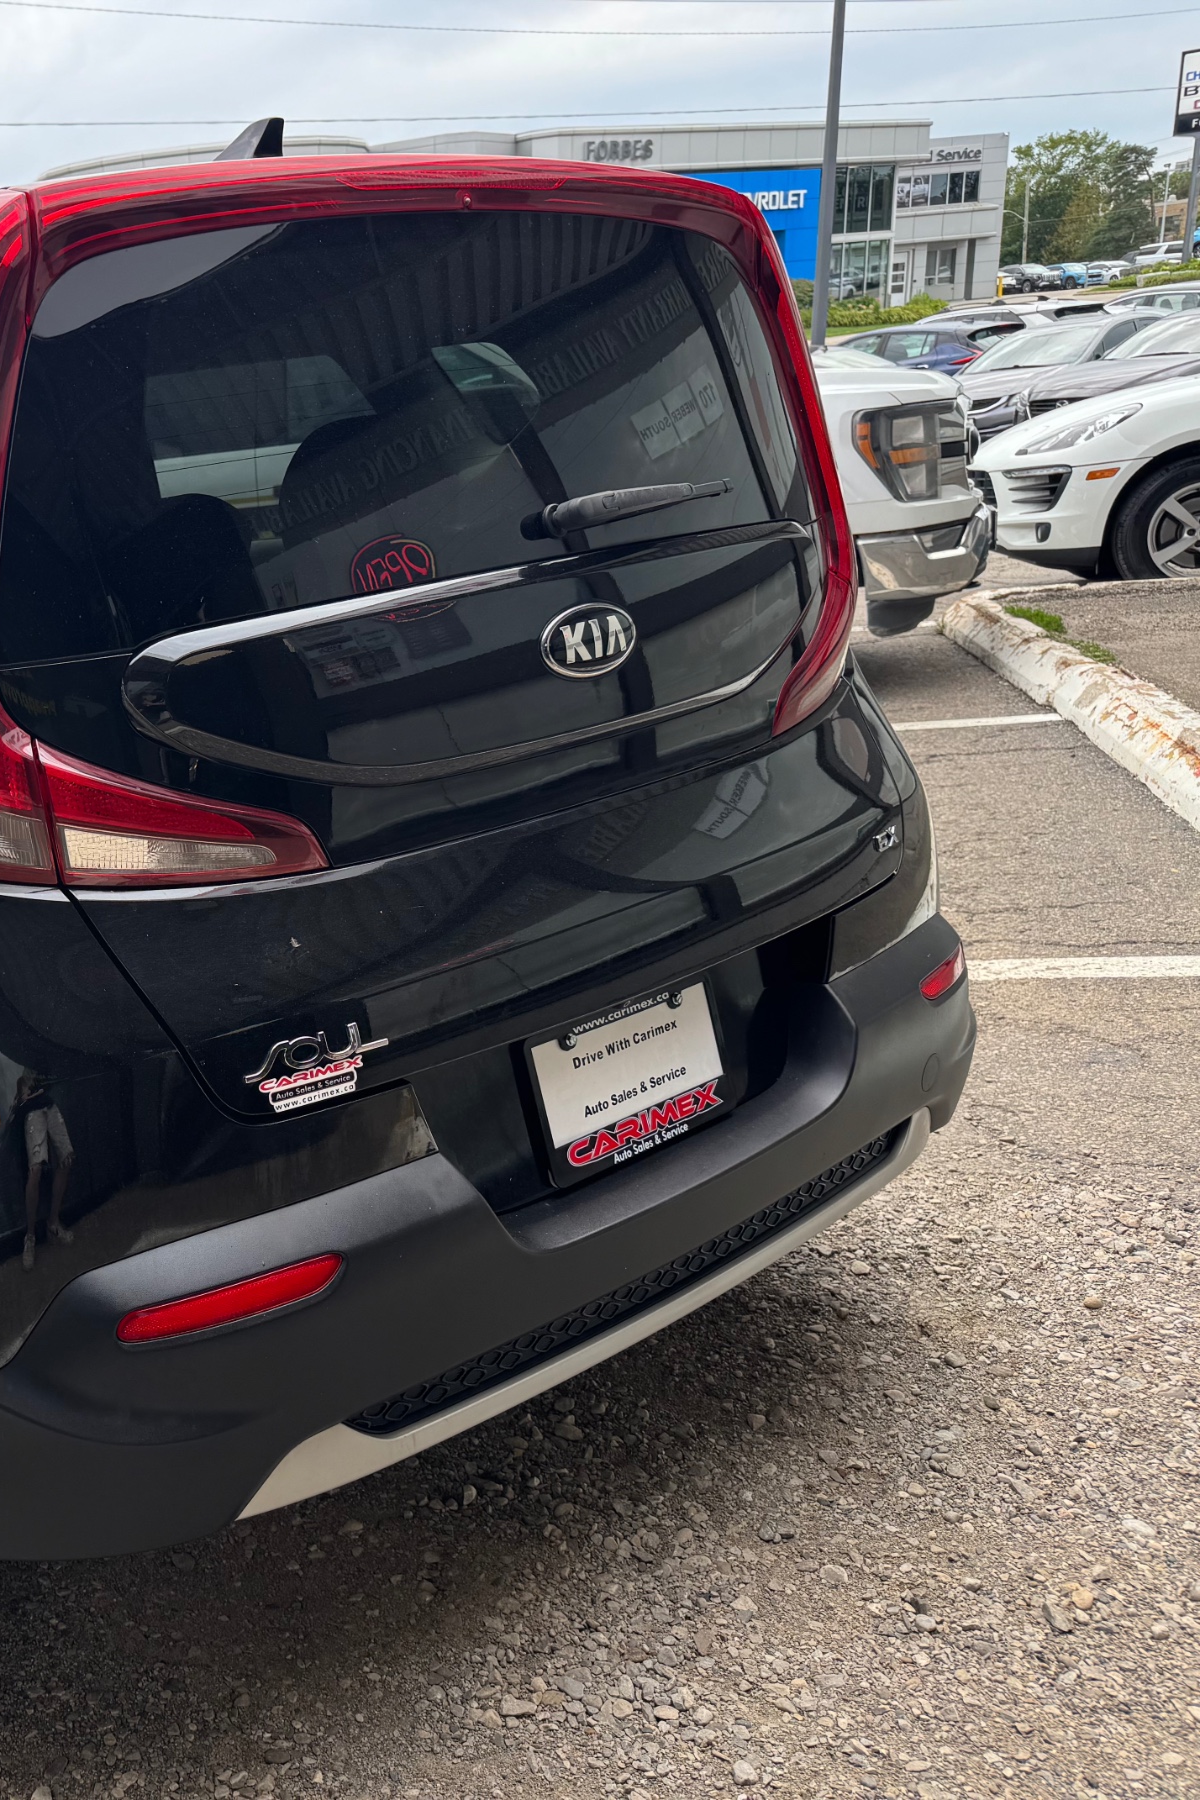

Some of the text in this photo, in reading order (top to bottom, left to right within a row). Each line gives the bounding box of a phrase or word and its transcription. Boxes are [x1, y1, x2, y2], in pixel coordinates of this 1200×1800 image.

[1184, 85, 1200, 97] B
[584, 139, 653, 162] FORBES
[936, 147, 982, 161] Service
[560, 615, 627, 665] KIA
[873, 825, 899, 852] EX
[573, 991, 670, 1035] www.carimex.ca
[572, 1019, 678, 1069] Drive With Carimex
[260, 1056, 362, 1091] CARIMEX
[276, 1091, 294, 1101] Auto
[296, 1084, 316, 1095] Sales
[325, 1075, 351, 1086] Service
[275, 1084, 354, 1110] www.carimex.ca
[584, 1066, 687, 1118] Auto Sales & Service
[567, 1079, 723, 1167] CARIMEX
[613, 1122, 688, 1164] Auto Sales & Service
